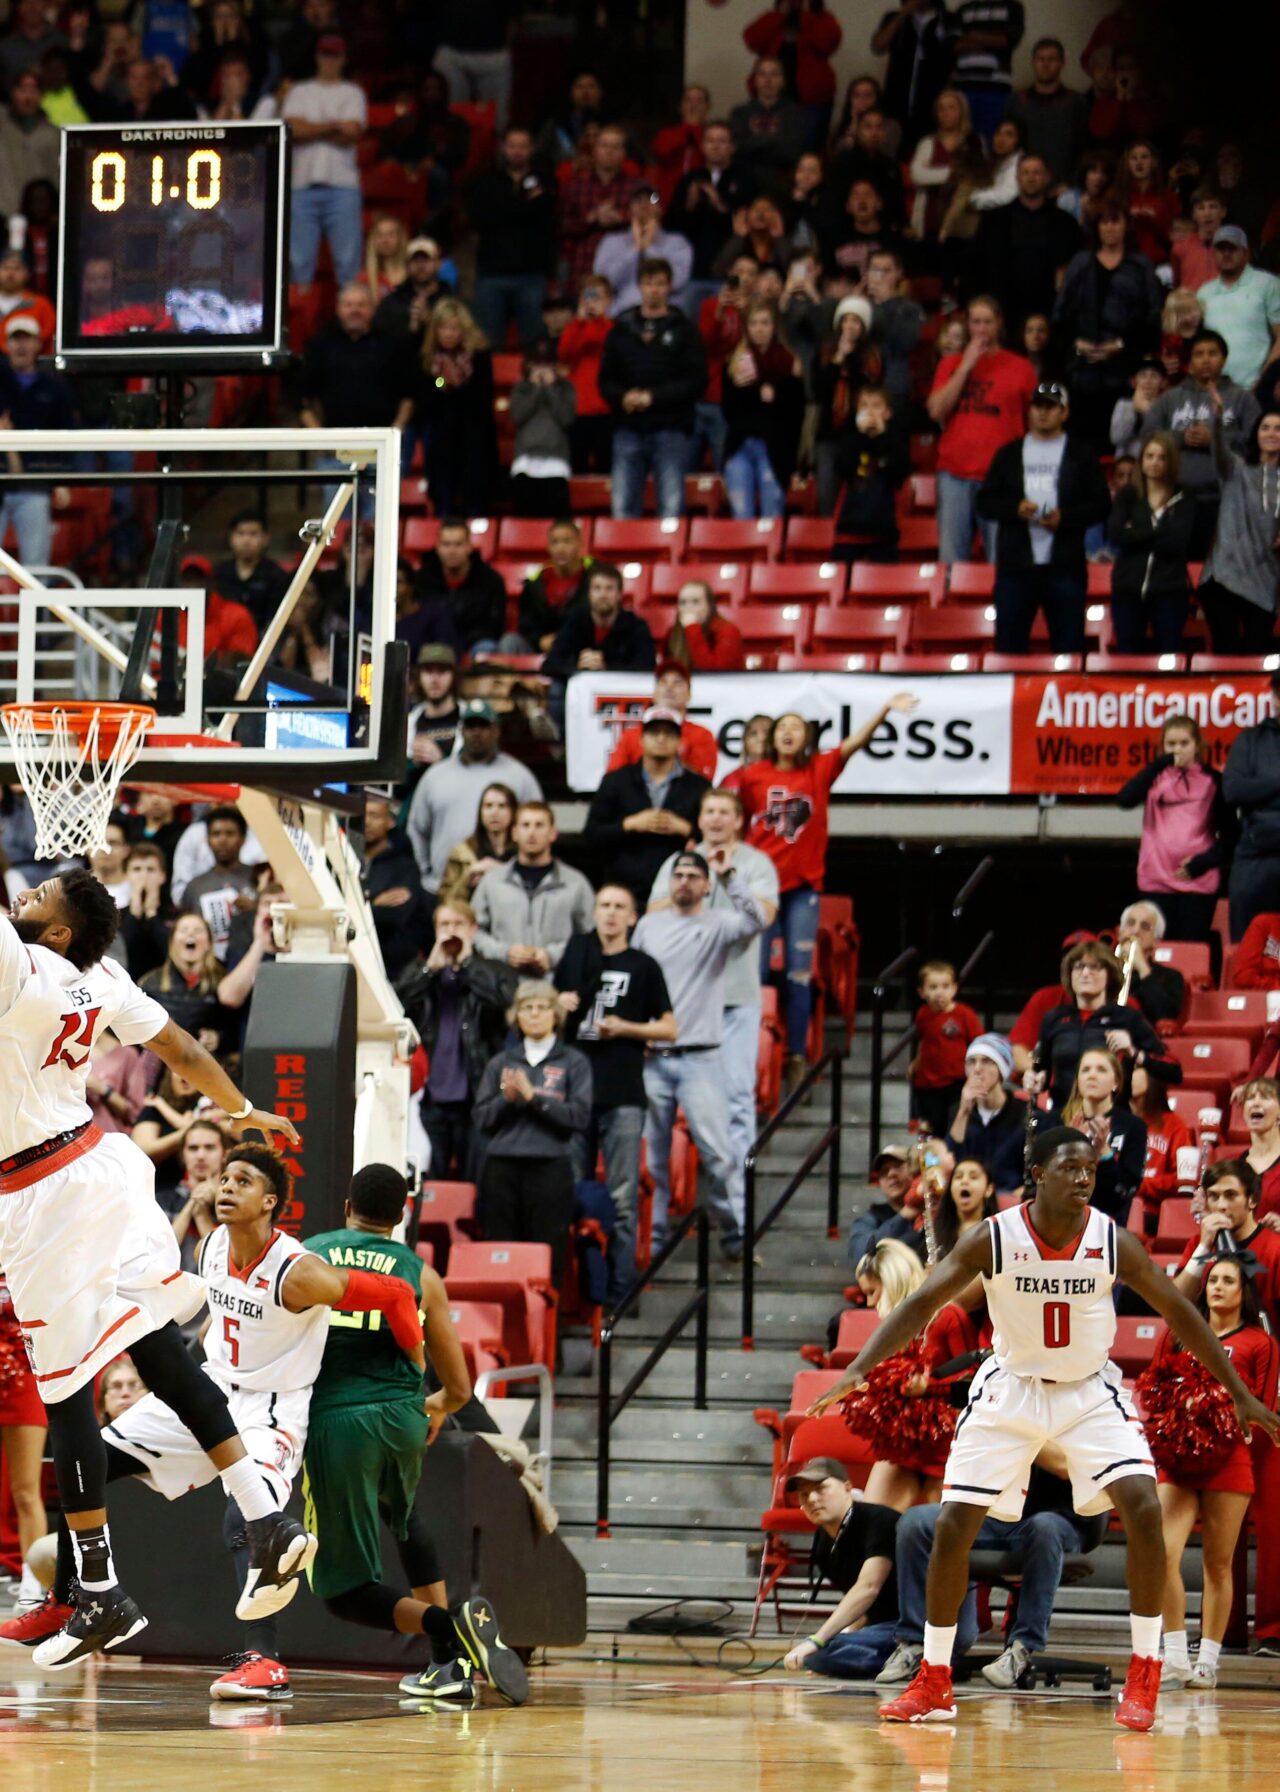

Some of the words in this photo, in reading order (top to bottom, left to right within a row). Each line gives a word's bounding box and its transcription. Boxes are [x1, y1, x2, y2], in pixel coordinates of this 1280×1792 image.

[121, 128, 226, 142] DAKTRONICS
[1036, 736, 1120, 768] Where
[274, 1054, 308, 1122] RED
[328, 1246, 397, 1275] MASTON
[1015, 1276, 1060, 1294] TEXAS
[1063, 1277, 1096, 1295] TECH
[209, 1287, 234, 1312] TEXAS
[238, 1300, 263, 1320] TECH
[1043, 1301, 1070, 1349] 0
[223, 1316, 241, 1367] 5
